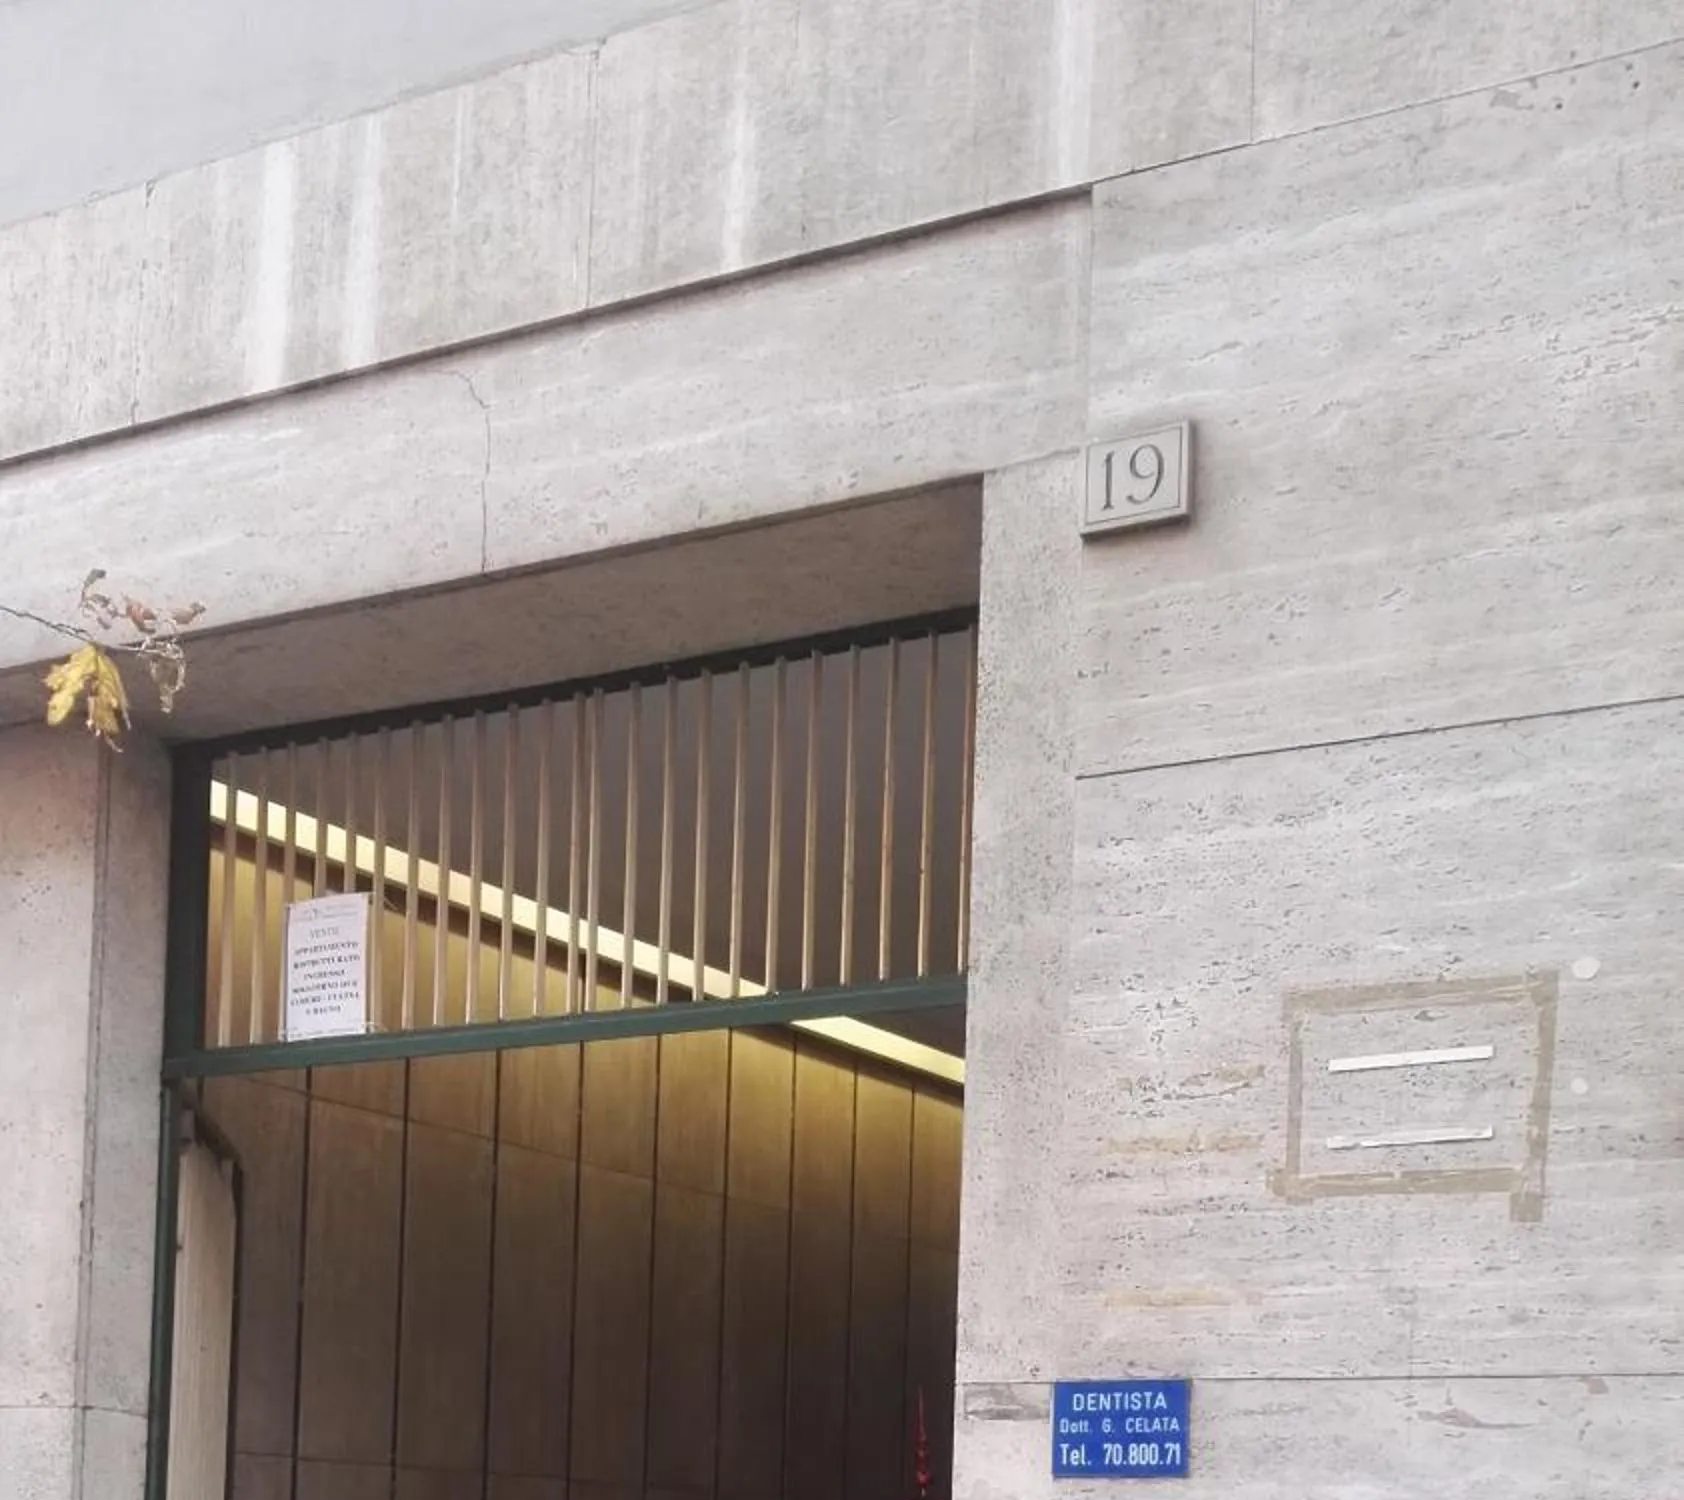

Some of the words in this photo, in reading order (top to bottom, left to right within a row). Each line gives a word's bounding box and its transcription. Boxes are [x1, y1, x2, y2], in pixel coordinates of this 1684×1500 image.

[1101, 443, 1165, 511] 19
[1072, 1391, 1168, 1412] DENTISTA
[1125, 1416, 1181, 1434] CELATA
[1060, 1443, 1092, 1466] Tel.
[1103, 1442, 1182, 1466] 70.800.71
